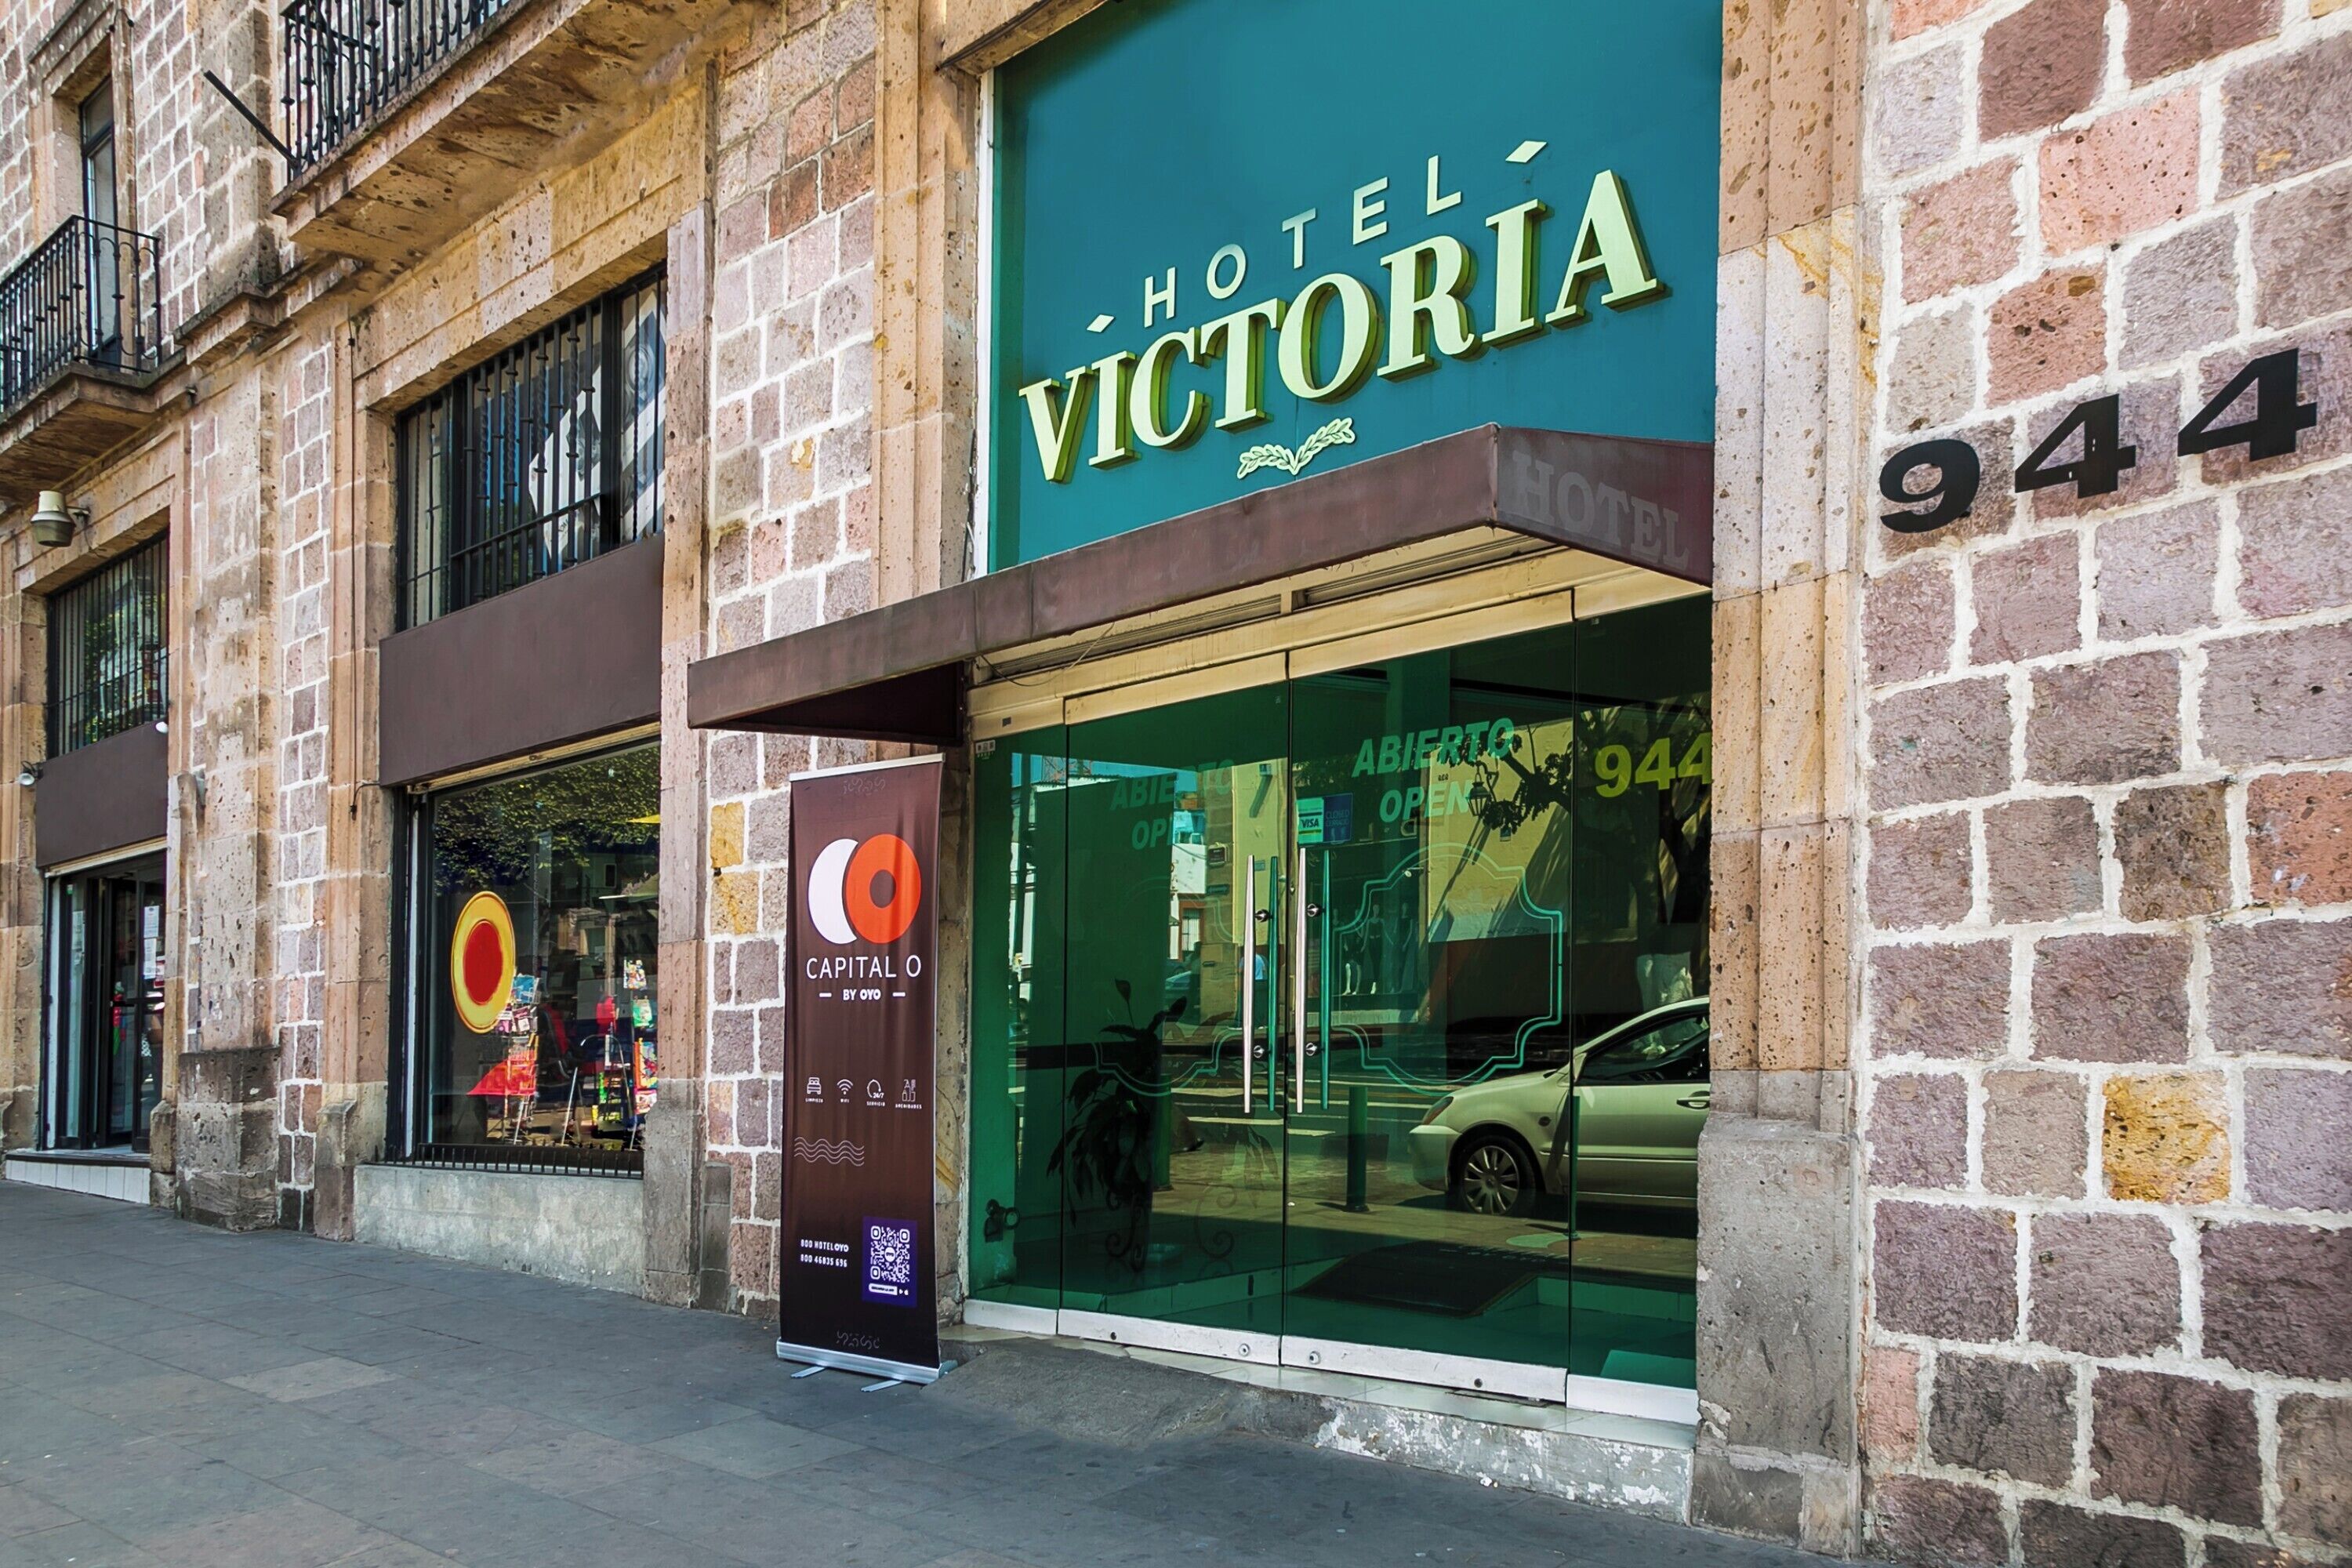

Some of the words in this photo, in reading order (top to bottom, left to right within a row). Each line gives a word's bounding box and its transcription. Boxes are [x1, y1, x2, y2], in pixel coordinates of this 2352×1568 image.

[1143, 154, 1462, 328] HOTEL
[1018, 169, 1672, 484] VICTORIA
[1879, 347, 2318, 533] 944
[1507, 450, 1690, 570] HOTEL
[1352, 717, 1515, 778] ABIERTO
[1595, 731, 1712, 798] 944
[1109, 759, 1235, 811] ABIETO
[1379, 779, 1473, 822] OPEN
[1301, 818, 1319, 829] VISA
[806, 956, 897, 979] CAPITAL
[906, 954, 922, 978] O
[843, 989, 857, 1000] BY
[859, 988, 881, 1000] OYO
[800, 1239, 813, 1248] 800
[800, 1254, 813, 1263] 800
[835, 1258, 848, 1268] 696
